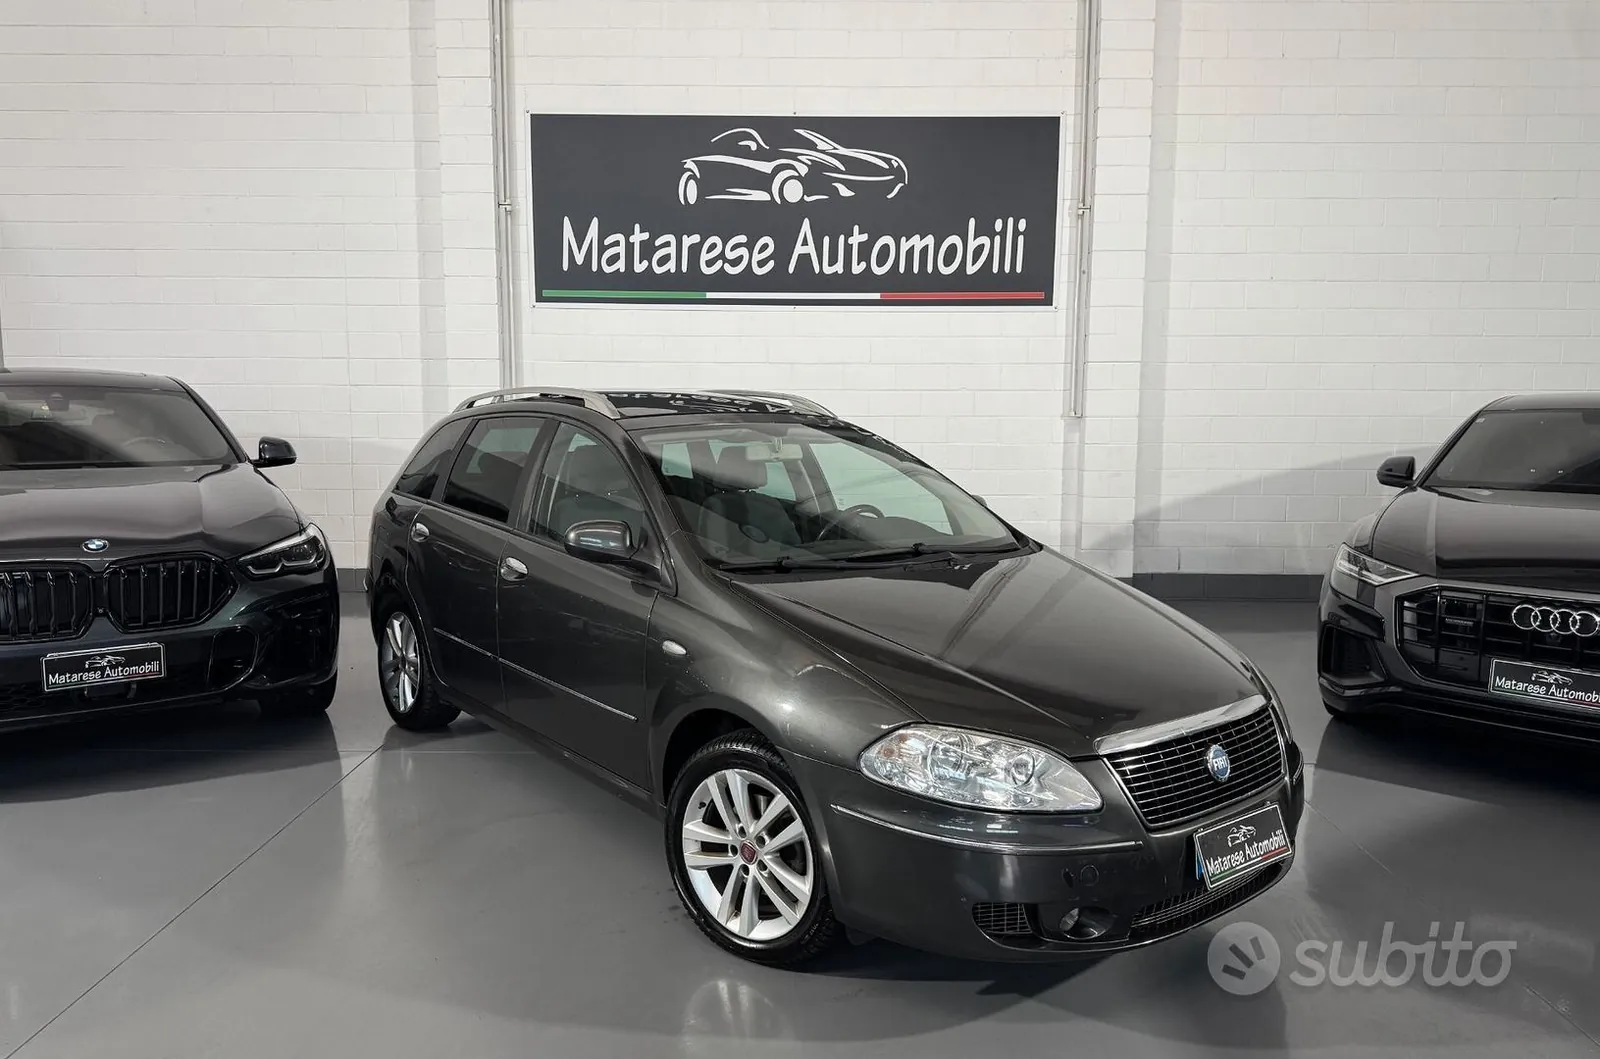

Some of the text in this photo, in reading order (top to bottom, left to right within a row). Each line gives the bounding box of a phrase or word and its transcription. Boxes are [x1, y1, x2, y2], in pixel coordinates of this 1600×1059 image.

[562, 216, 1027, 276] Matarese Automobili
[48, 661, 160, 686] Matarese Automobili
[1494, 675, 1546, 695] Matarese
[1214, 756, 1229, 771] FIAT
[1206, 830, 1286, 876] Matarese Automobili
